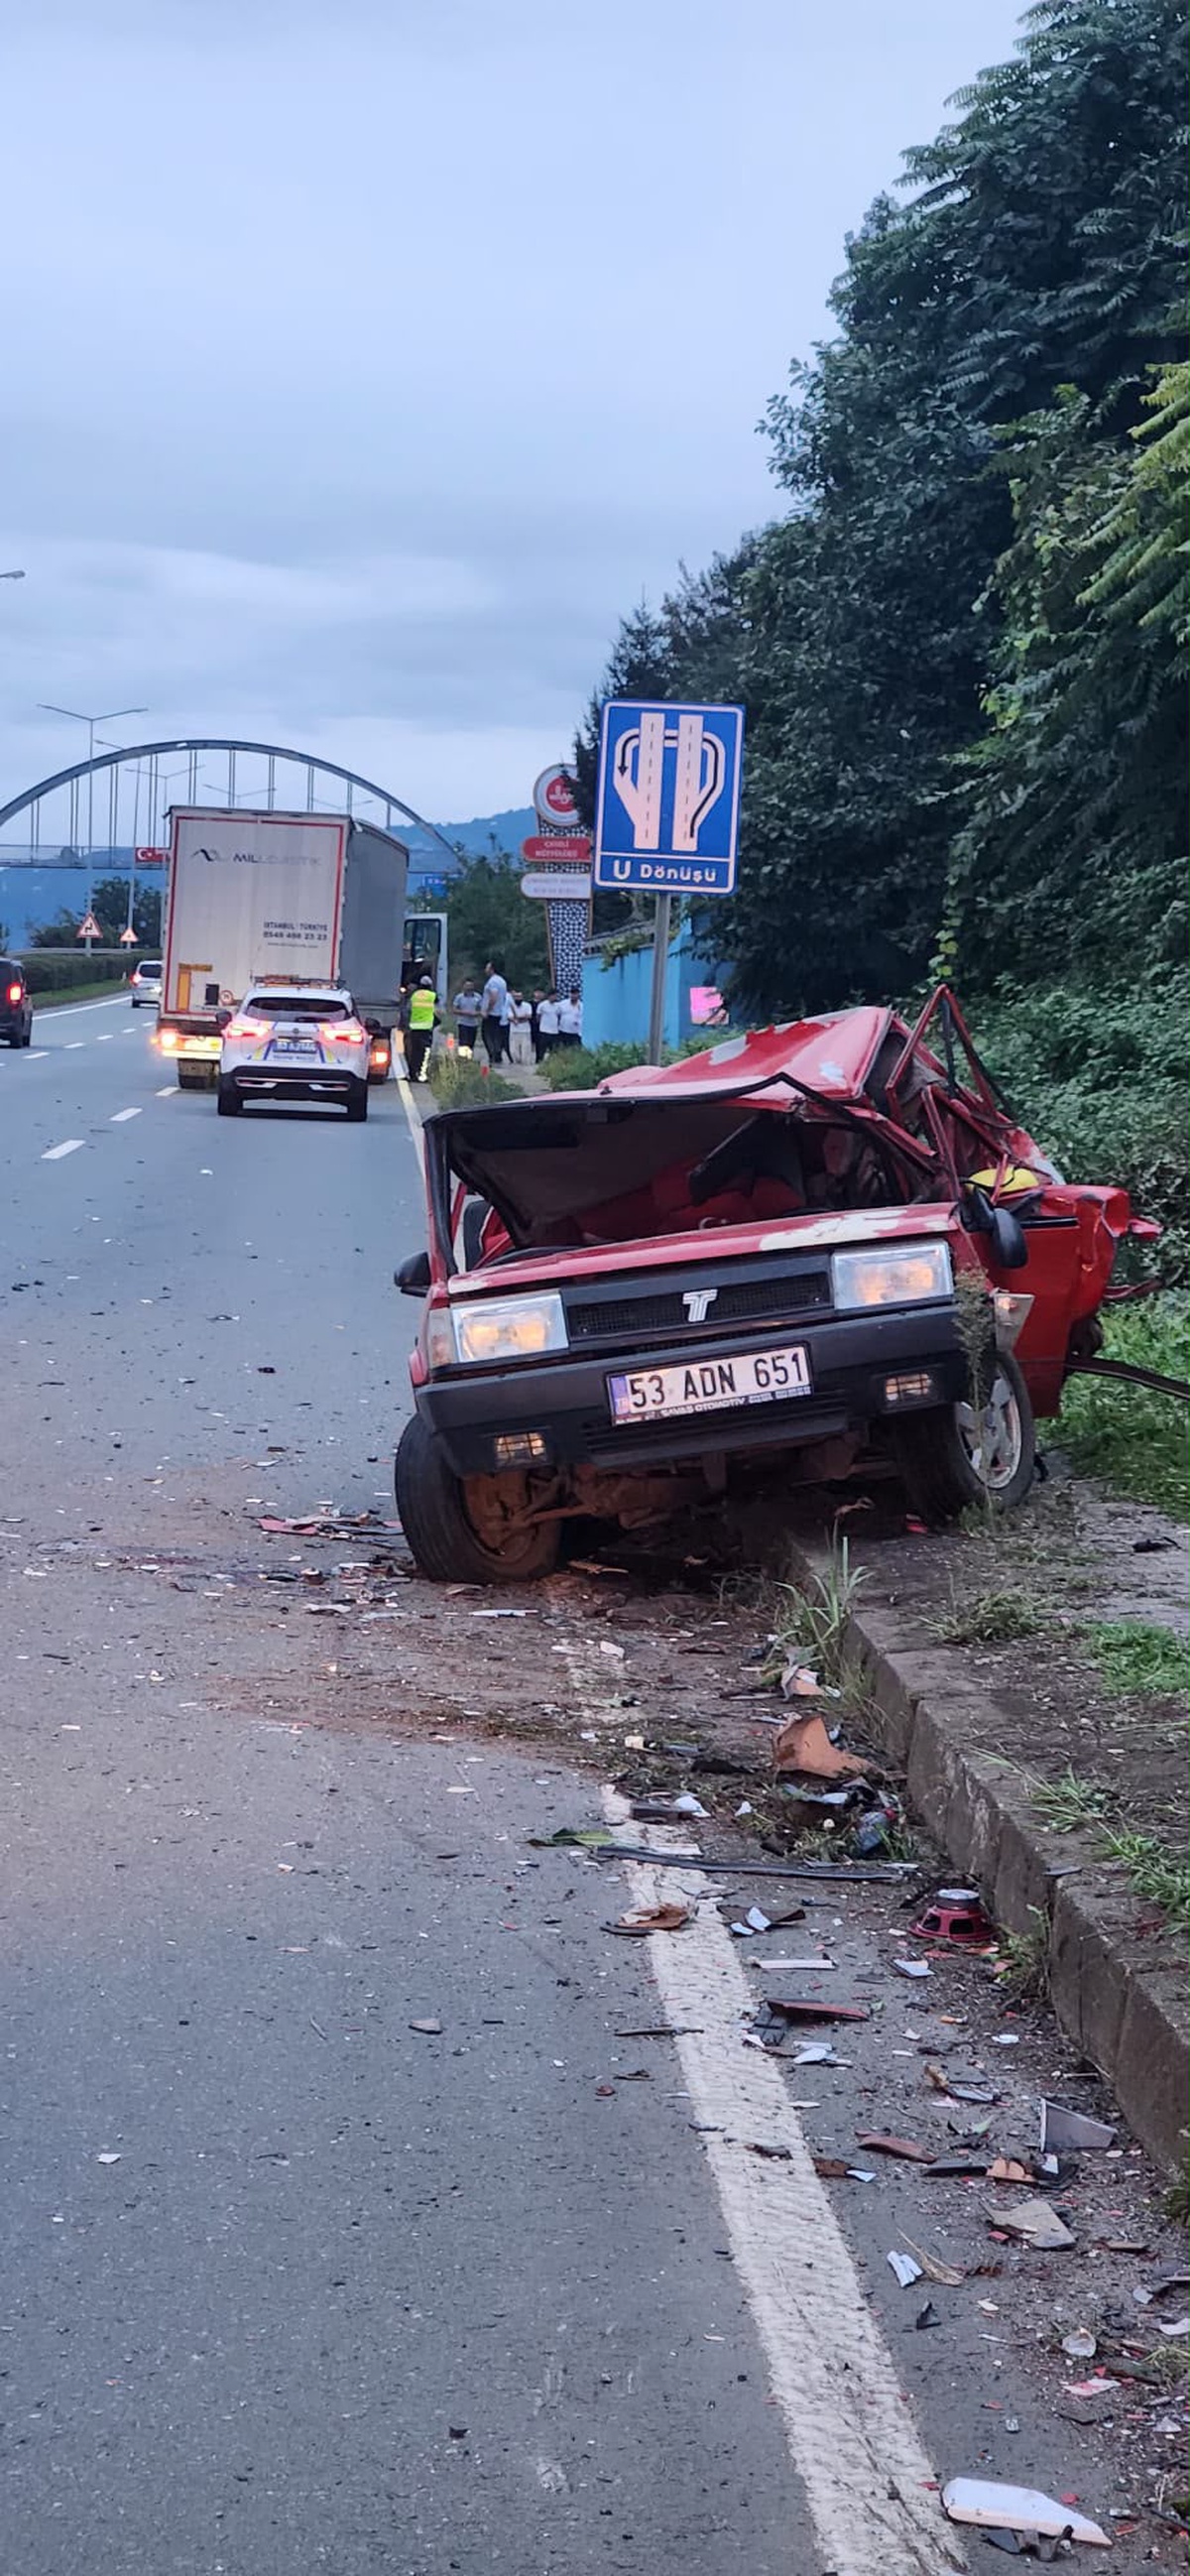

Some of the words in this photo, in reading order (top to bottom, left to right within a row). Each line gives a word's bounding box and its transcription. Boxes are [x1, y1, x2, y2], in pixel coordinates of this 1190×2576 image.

[613, 859, 632, 880] U
[640, 863, 717, 883] Dönüşü
[629, 1375, 665, 1409] 53
[683, 1363, 737, 1401] ADN
[754, 1352, 804, 1389] 651
